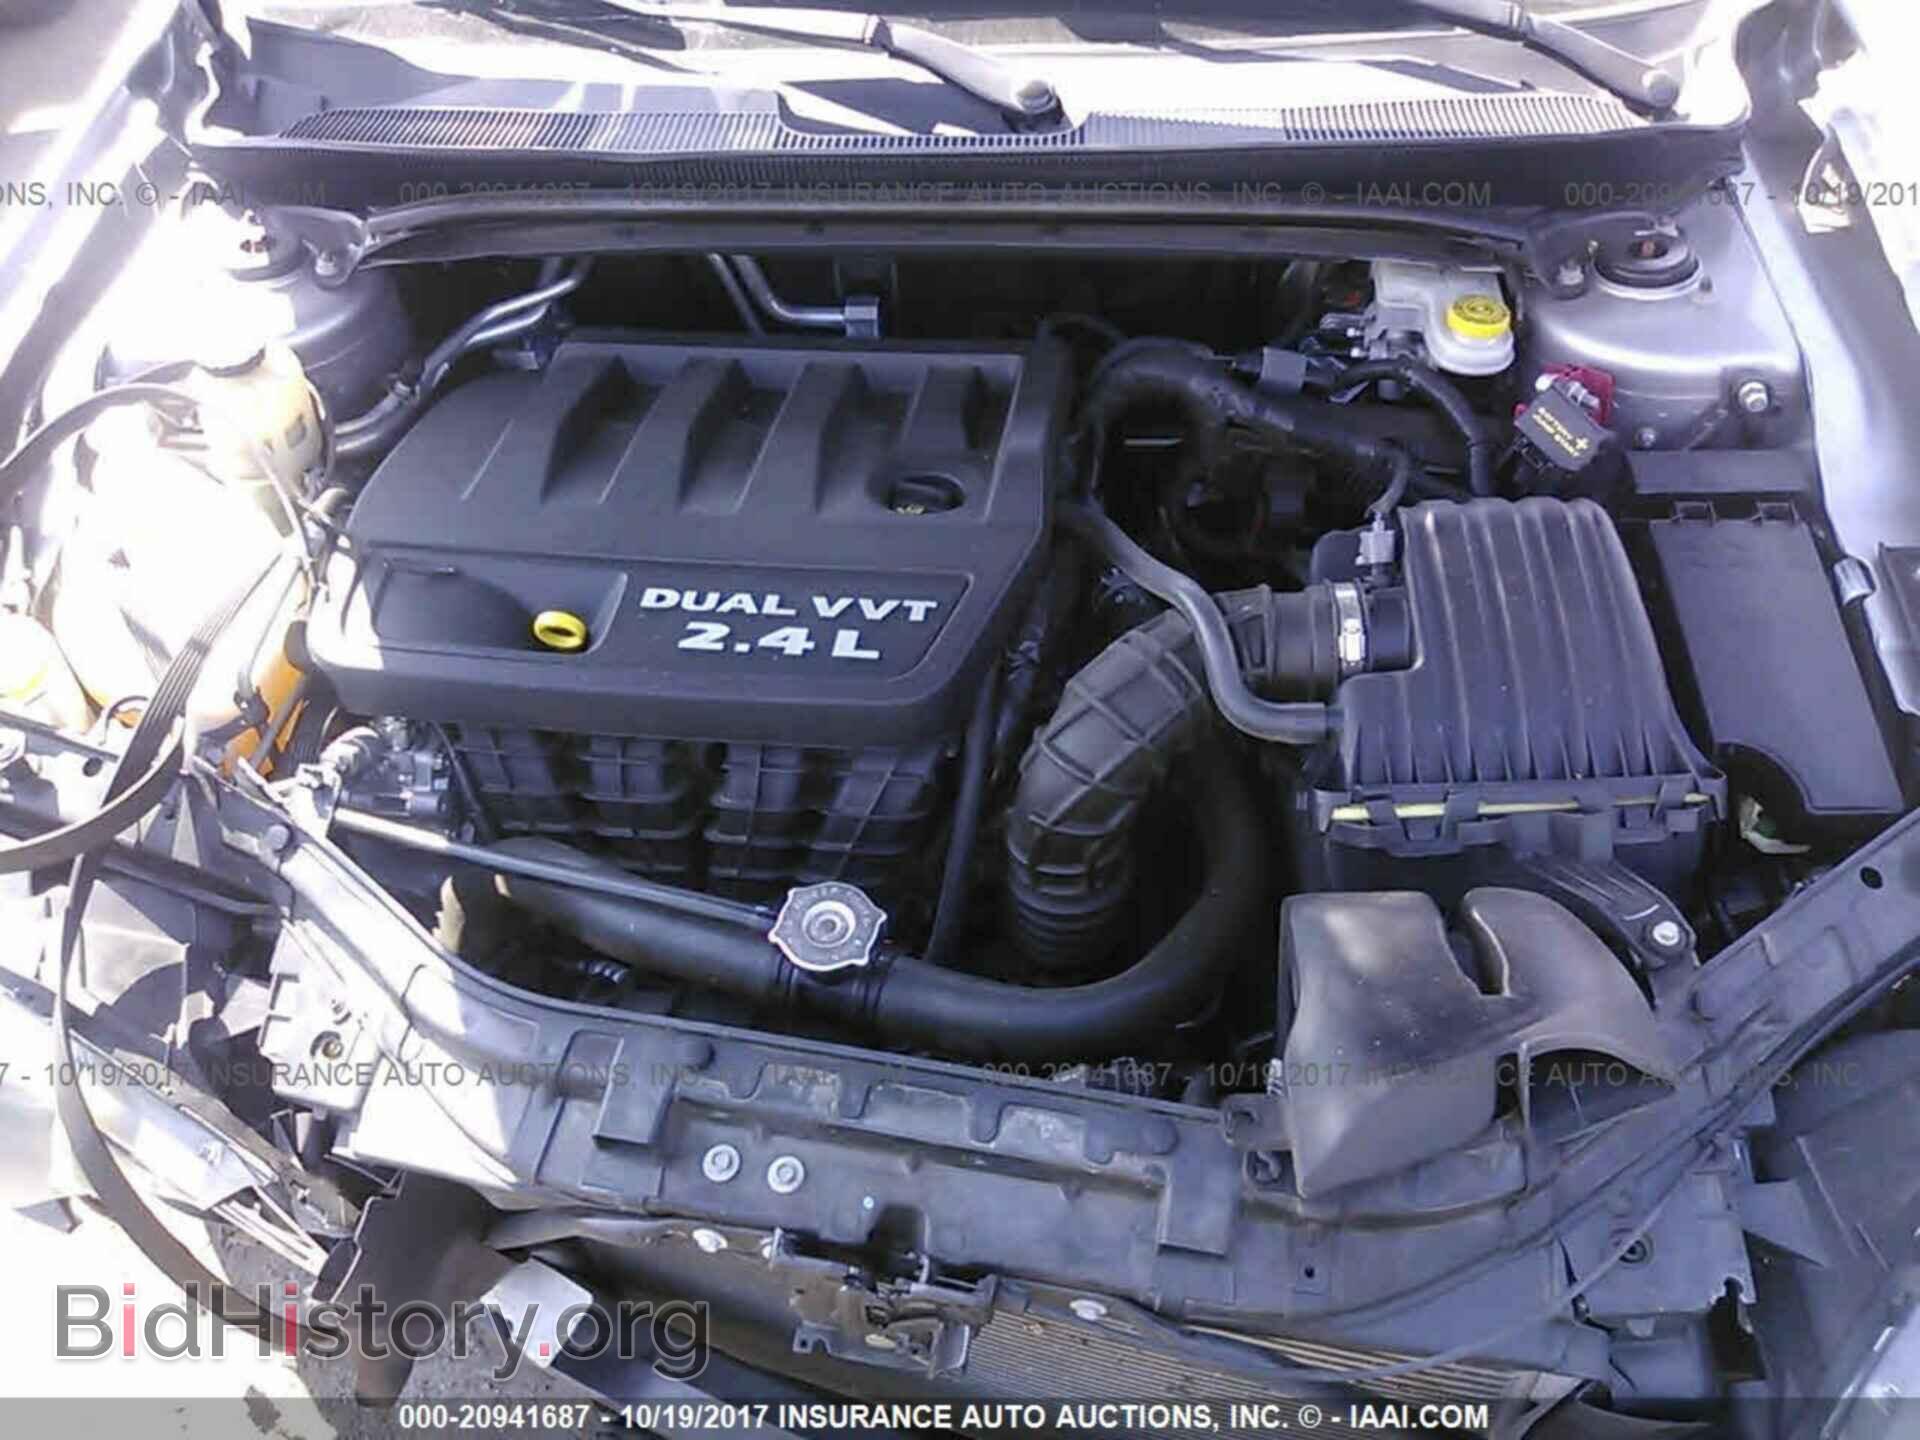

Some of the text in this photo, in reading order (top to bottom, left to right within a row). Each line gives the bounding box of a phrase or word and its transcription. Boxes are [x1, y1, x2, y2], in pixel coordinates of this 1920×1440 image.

[640, 587, 937, 621] DUAL VVT
[678, 621, 880, 660] 2.4 L
